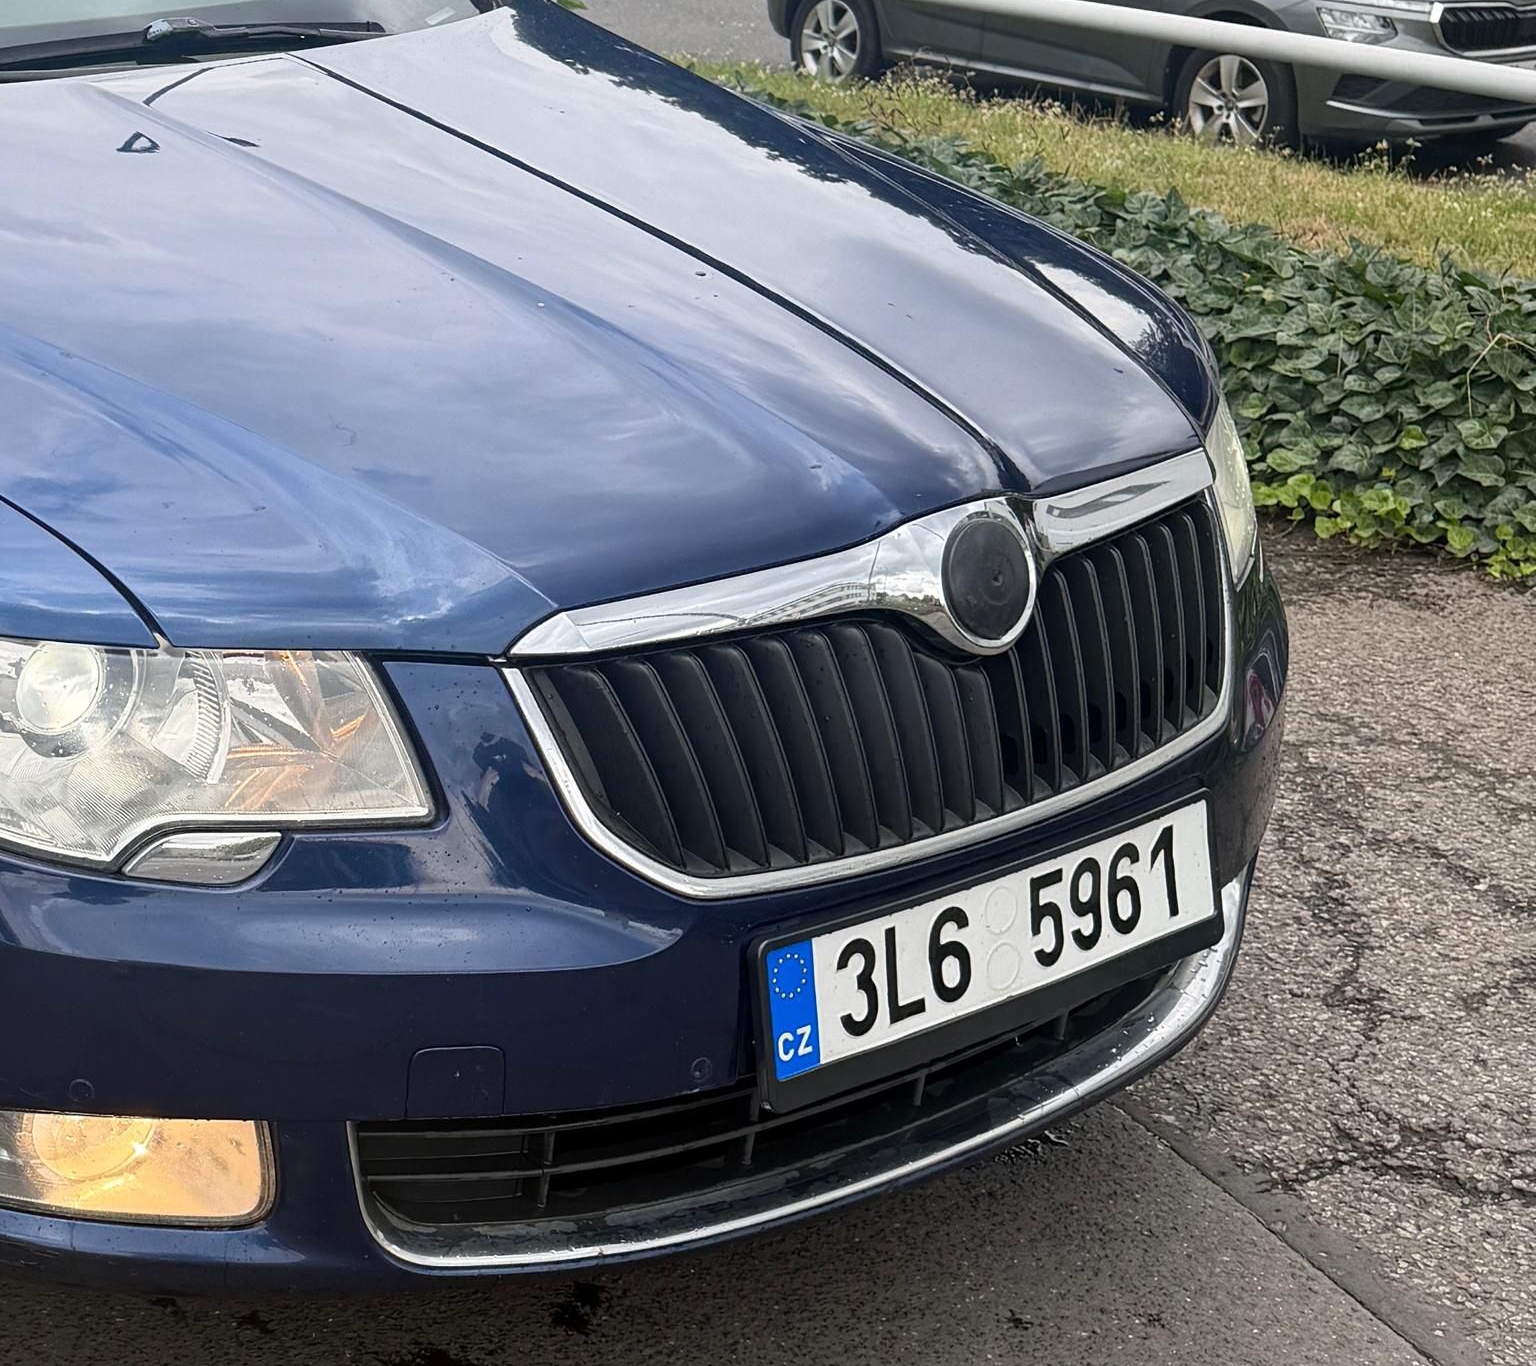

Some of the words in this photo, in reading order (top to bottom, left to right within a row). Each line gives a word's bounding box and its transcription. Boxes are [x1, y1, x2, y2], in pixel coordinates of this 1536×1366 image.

[836, 905, 972, 1037] 3L6
[1029, 824, 1180, 968] 5961
[778, 1025, 813, 1062] CZ
